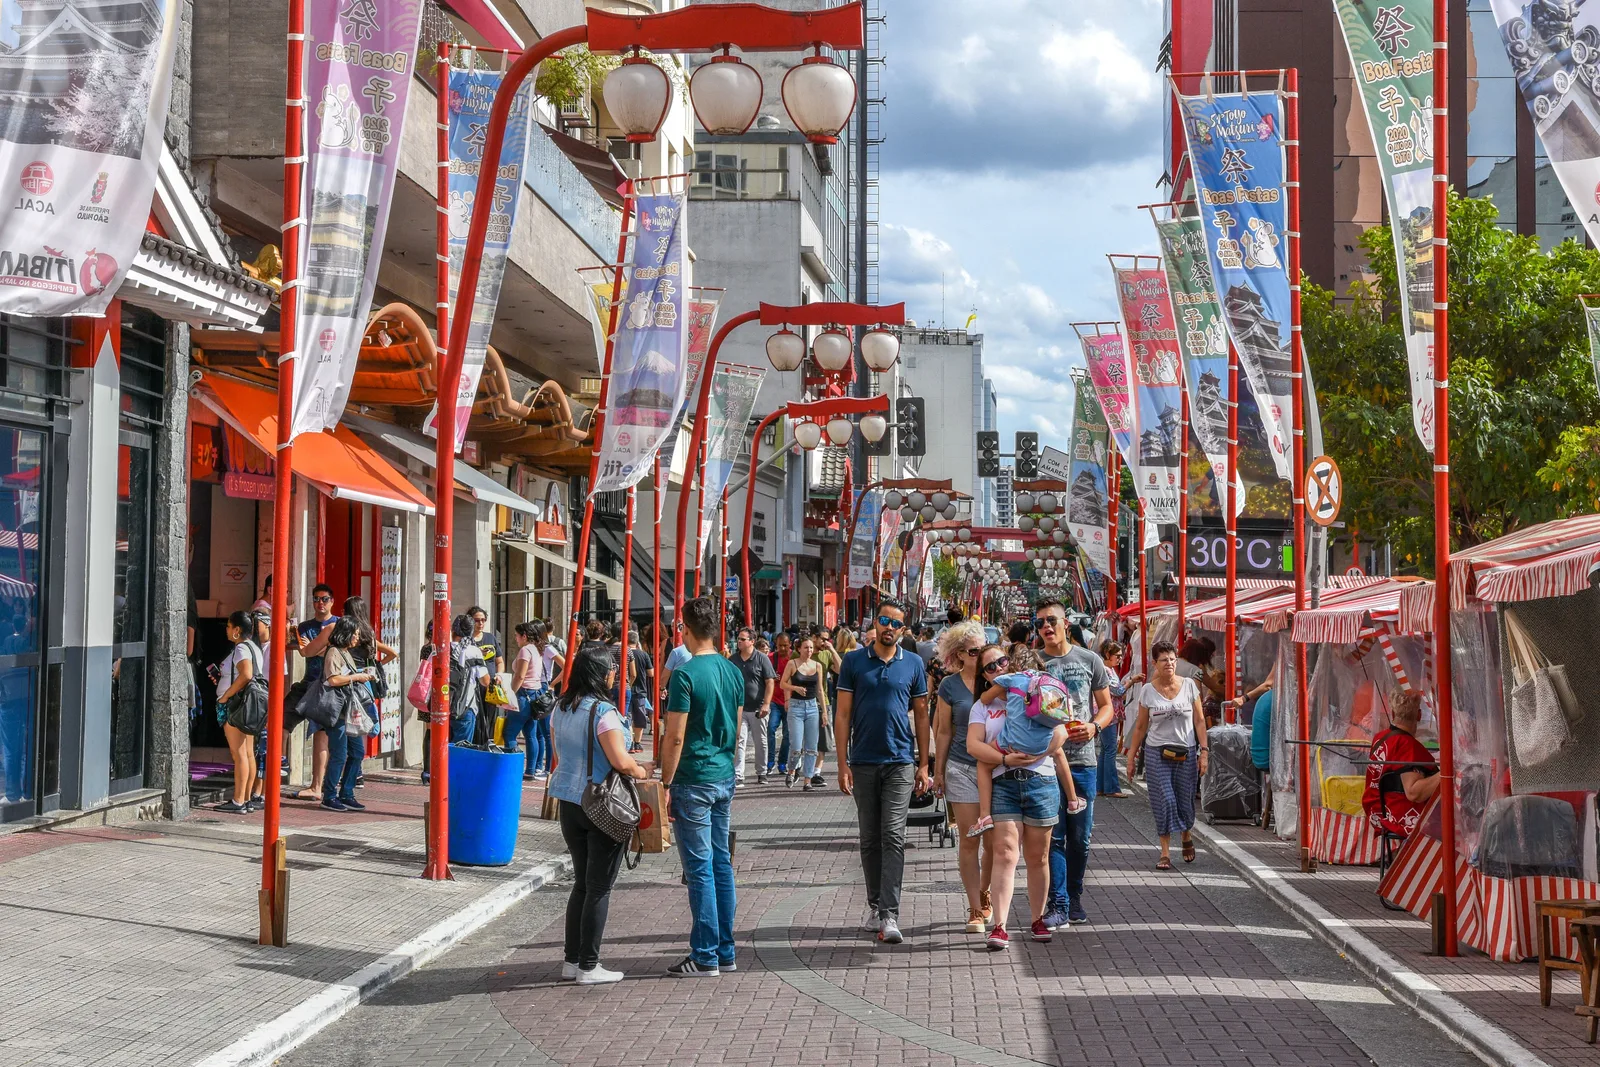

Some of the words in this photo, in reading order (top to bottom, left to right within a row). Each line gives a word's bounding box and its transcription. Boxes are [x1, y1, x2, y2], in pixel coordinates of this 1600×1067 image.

[1373, 5, 1415, 55] 祭
[1361, 60, 1393, 84] Boa
[1392, 51, 1434, 76] Festa
[1379, 86, 1403, 123] 子
[1224, 108, 1247, 124] Toyo
[1387, 126, 1409, 142] 2020
[1218, 146, 1255, 185] 祭
[1203, 188, 1236, 205] Boas
[1213, 210, 1236, 239] 子
[1190, 261, 1211, 287] 祭
[1176, 293, 1201, 304] Boas
[1140, 303, 1163, 327] 祭
[1184, 308, 1202, 331] 子
[1108, 362, 1124, 383] 祭
[1047, 458, 1060, 467] COM
[239, 477, 257, 493] frozen
[1150, 497, 1179, 508] NIKKEY
